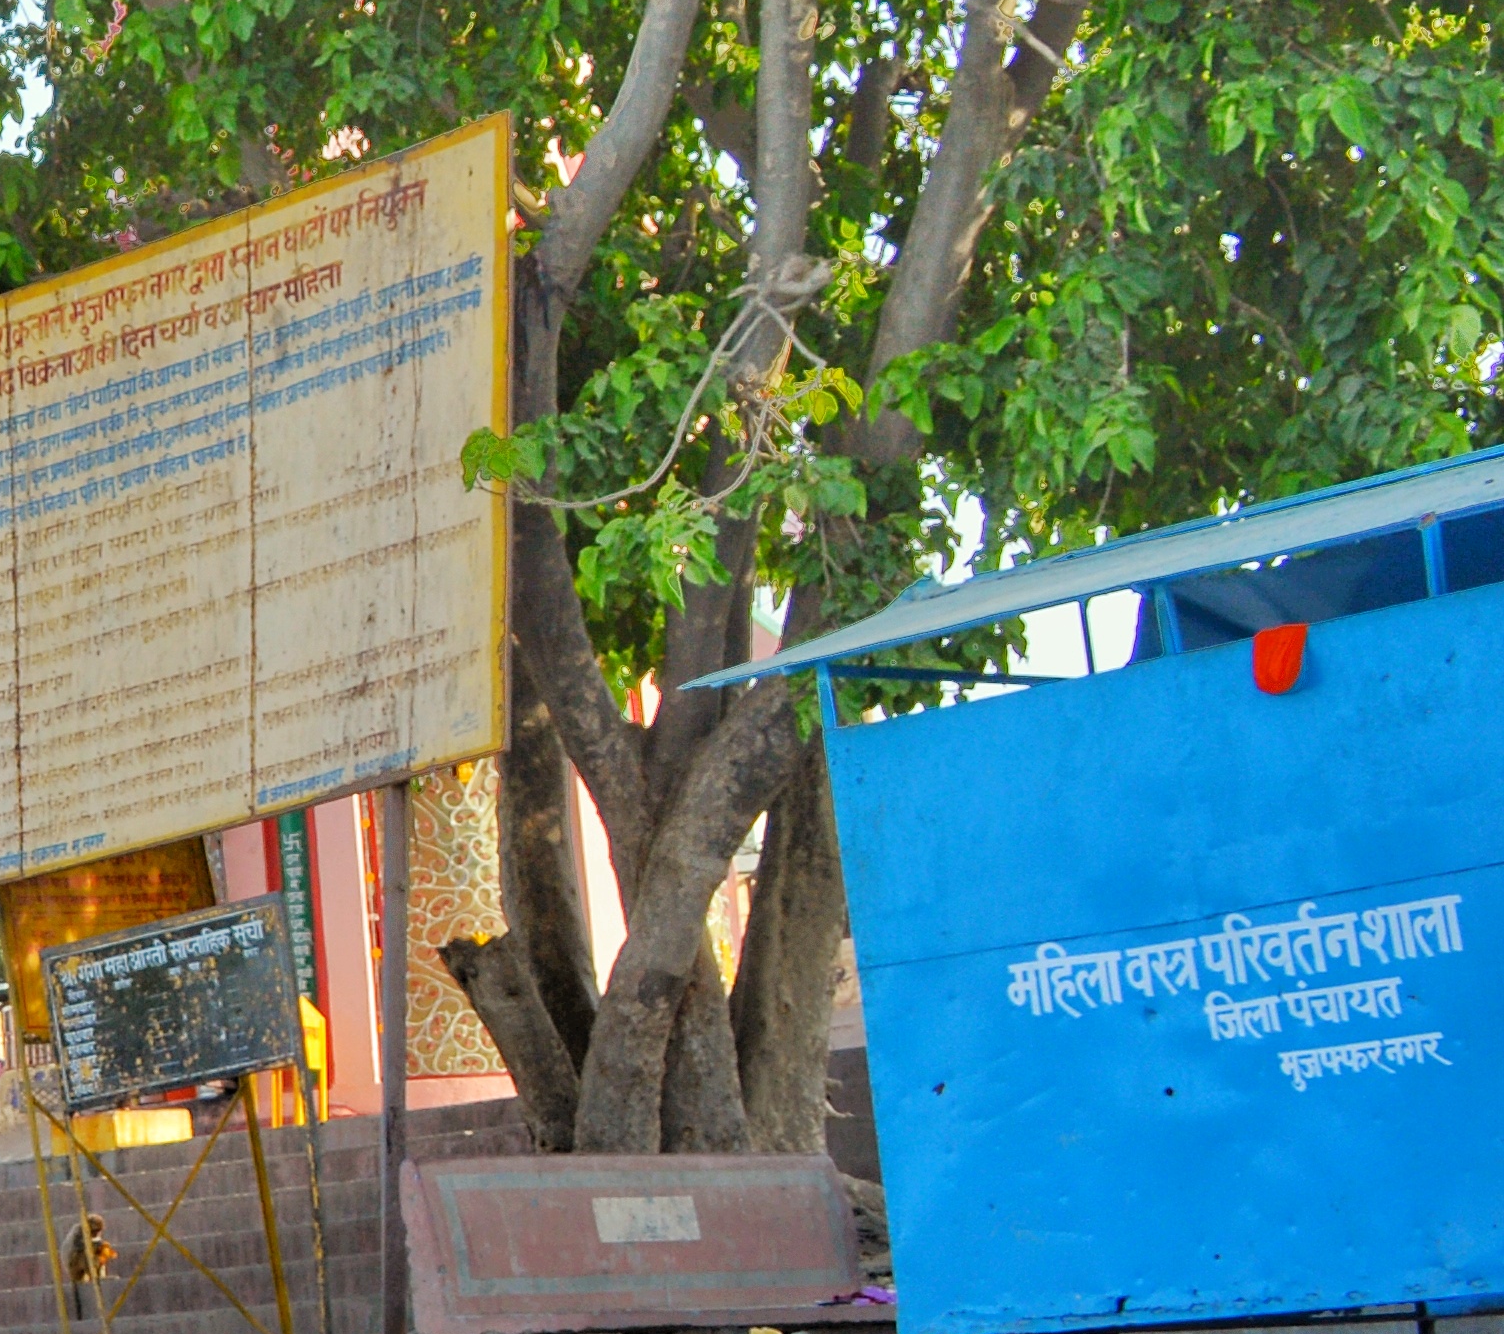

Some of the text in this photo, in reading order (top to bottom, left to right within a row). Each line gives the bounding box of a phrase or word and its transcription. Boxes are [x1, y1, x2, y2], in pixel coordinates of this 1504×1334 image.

[329, 204, 352, 238] पर
[121, 322, 157, 358] दिन
[1007, 942, 1123, 1018] महिला
[1126, 939, 1200, 997] वस्त्र
[1205, 977, 1402, 1041] जिला पंचायत
